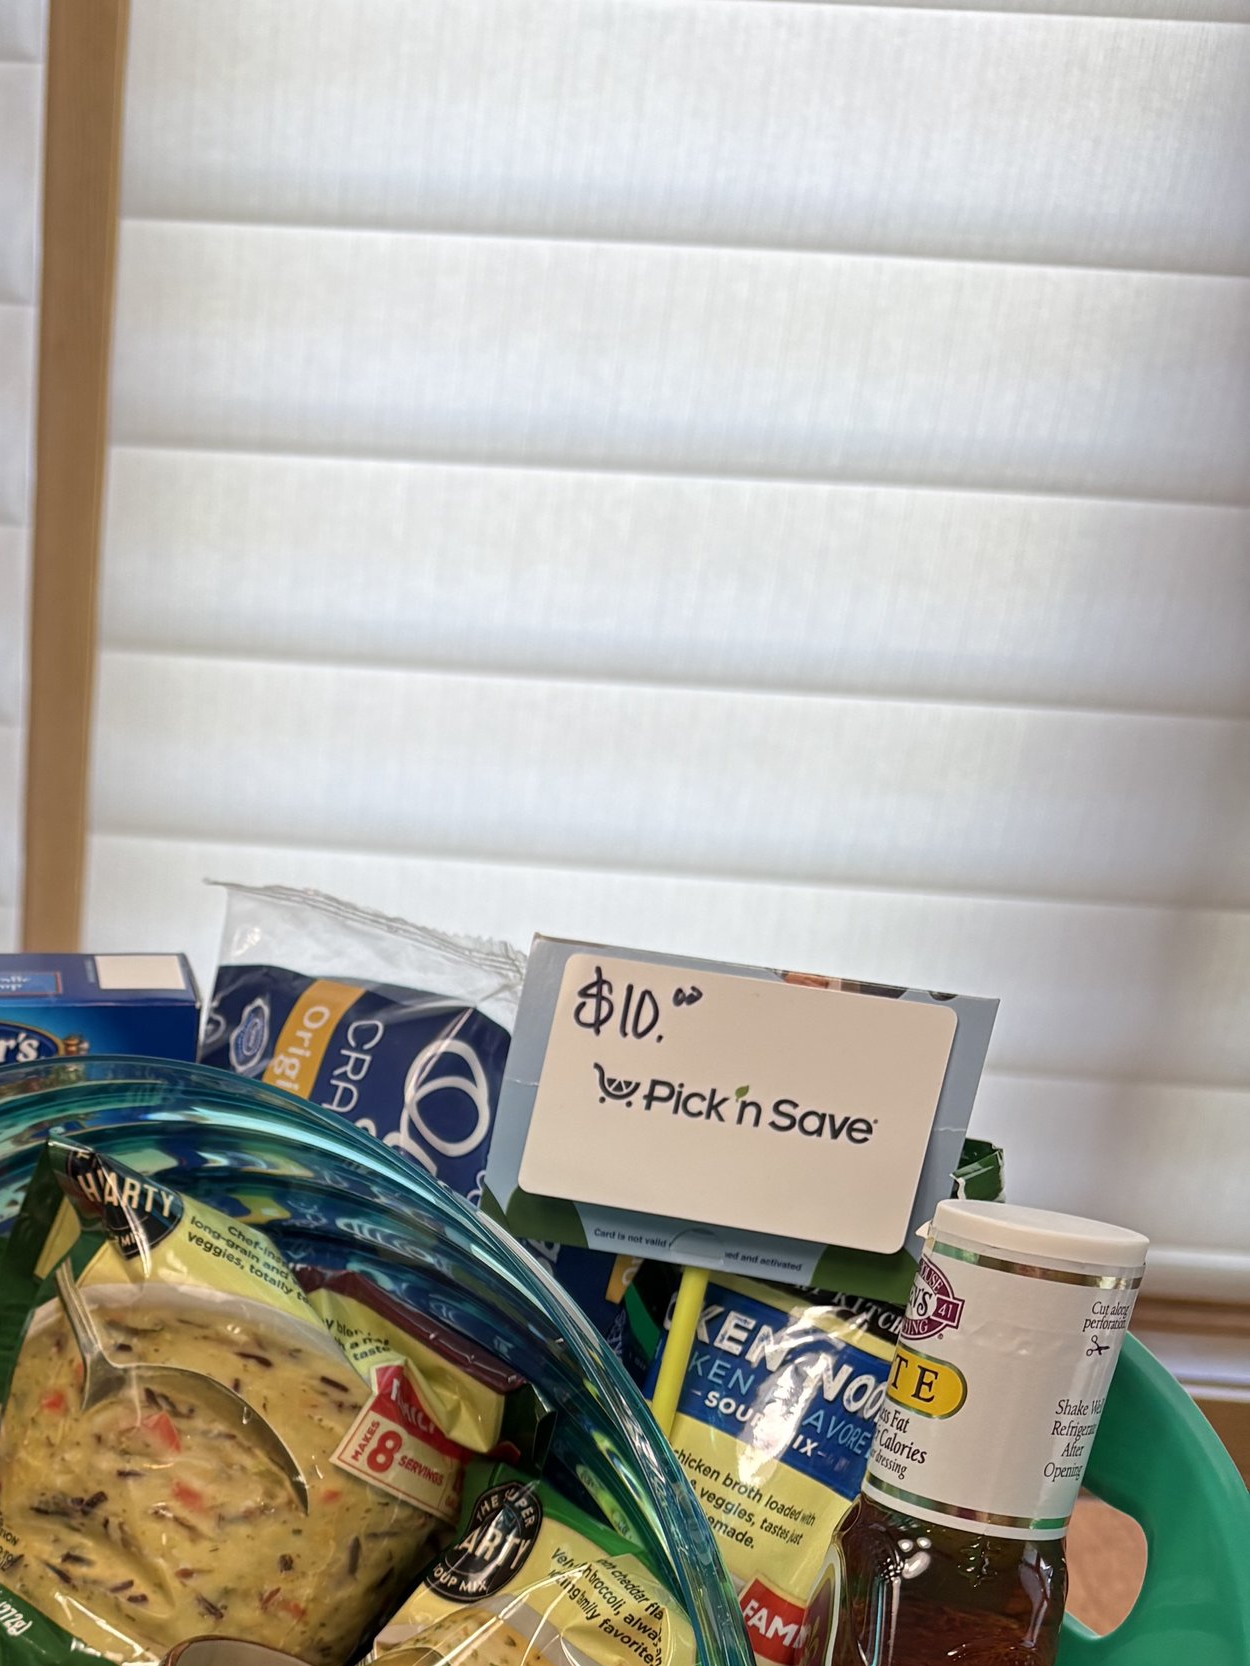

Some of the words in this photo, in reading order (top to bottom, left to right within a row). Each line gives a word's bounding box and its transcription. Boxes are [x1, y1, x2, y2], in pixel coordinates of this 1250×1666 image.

[642, 1078, 726, 1122] Pick
[768, 1098, 875, 1145] Save
[187, 1231, 245, 1271] veggies,
[249, 1264, 294, 1295] totally
[190, 1216, 260, 1264] long-grain
[263, 1261, 290, 1281] and
[937, 1303, 955, 1319] 41
[1092, 1301, 1110, 1316] Cut
[891, 1408, 910, 1434] Fat
[1055, 1399, 1089, 1416] Shake
[351, 1420, 380, 1462] MAKES
[367, 1430, 403, 1473] 8
[398, 1455, 444, 1486] SERVINGS
[792, 1434, 819, 1458] IX
[879, 1427, 928, 1465] Calories
[1061, 1442, 1084, 1458] After
[875, 1447, 908, 1480] dressing
[1044, 1462, 1083, 1482] Opening
[722, 1472, 762, 1504] broth
[765, 1495, 803, 1521] loaded
[700, 1488, 756, 1527] veggies,
[760, 1517, 789, 1541] tastes
[705, 1513, 756, 1549] emade.
[453, 1526, 530, 1570] ARTY
[459, 1579, 487, 1592] MIX
